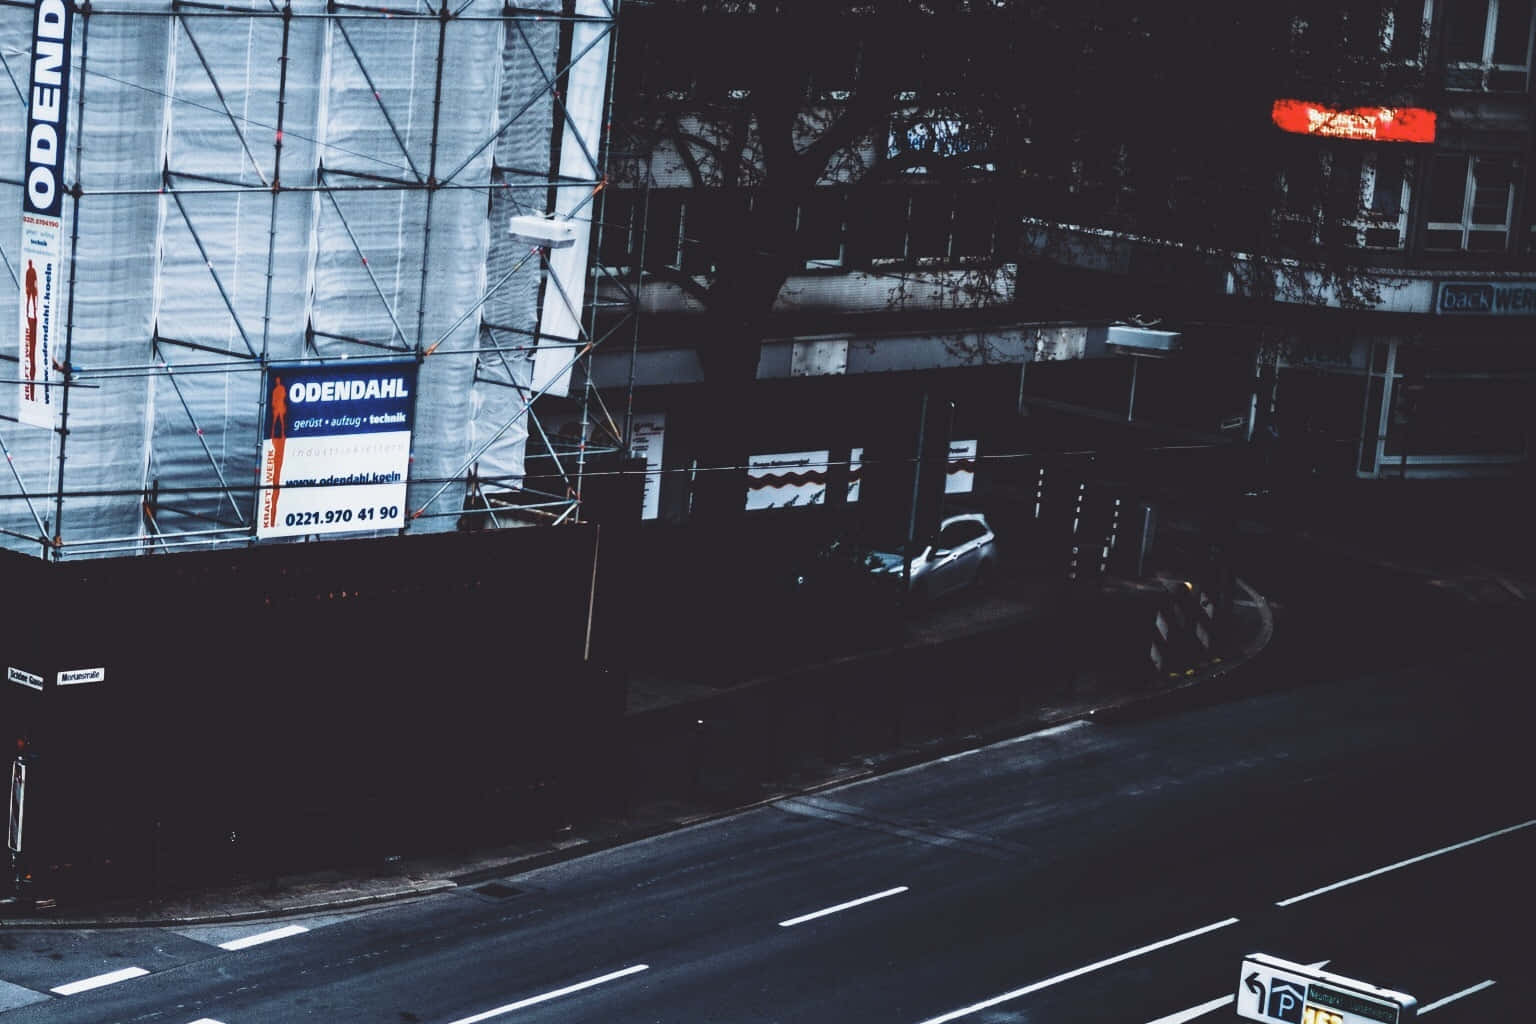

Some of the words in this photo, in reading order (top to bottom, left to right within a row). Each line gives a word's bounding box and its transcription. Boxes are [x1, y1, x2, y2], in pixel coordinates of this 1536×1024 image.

[28, 0, 66, 209] ODEND
[289, 378, 408, 403] ODENDAHL
[294, 417, 322, 431] gerüst
[331, 415, 361, 428] aufzug
[369, 412, 406, 425] technik
[265, 449, 274, 482] WERK
[263, 489, 271, 528] KRAFT
[285, 508, 352, 527] 0221.970
[357, 507, 374, 521] 41
[379, 505, 398, 519] 90
